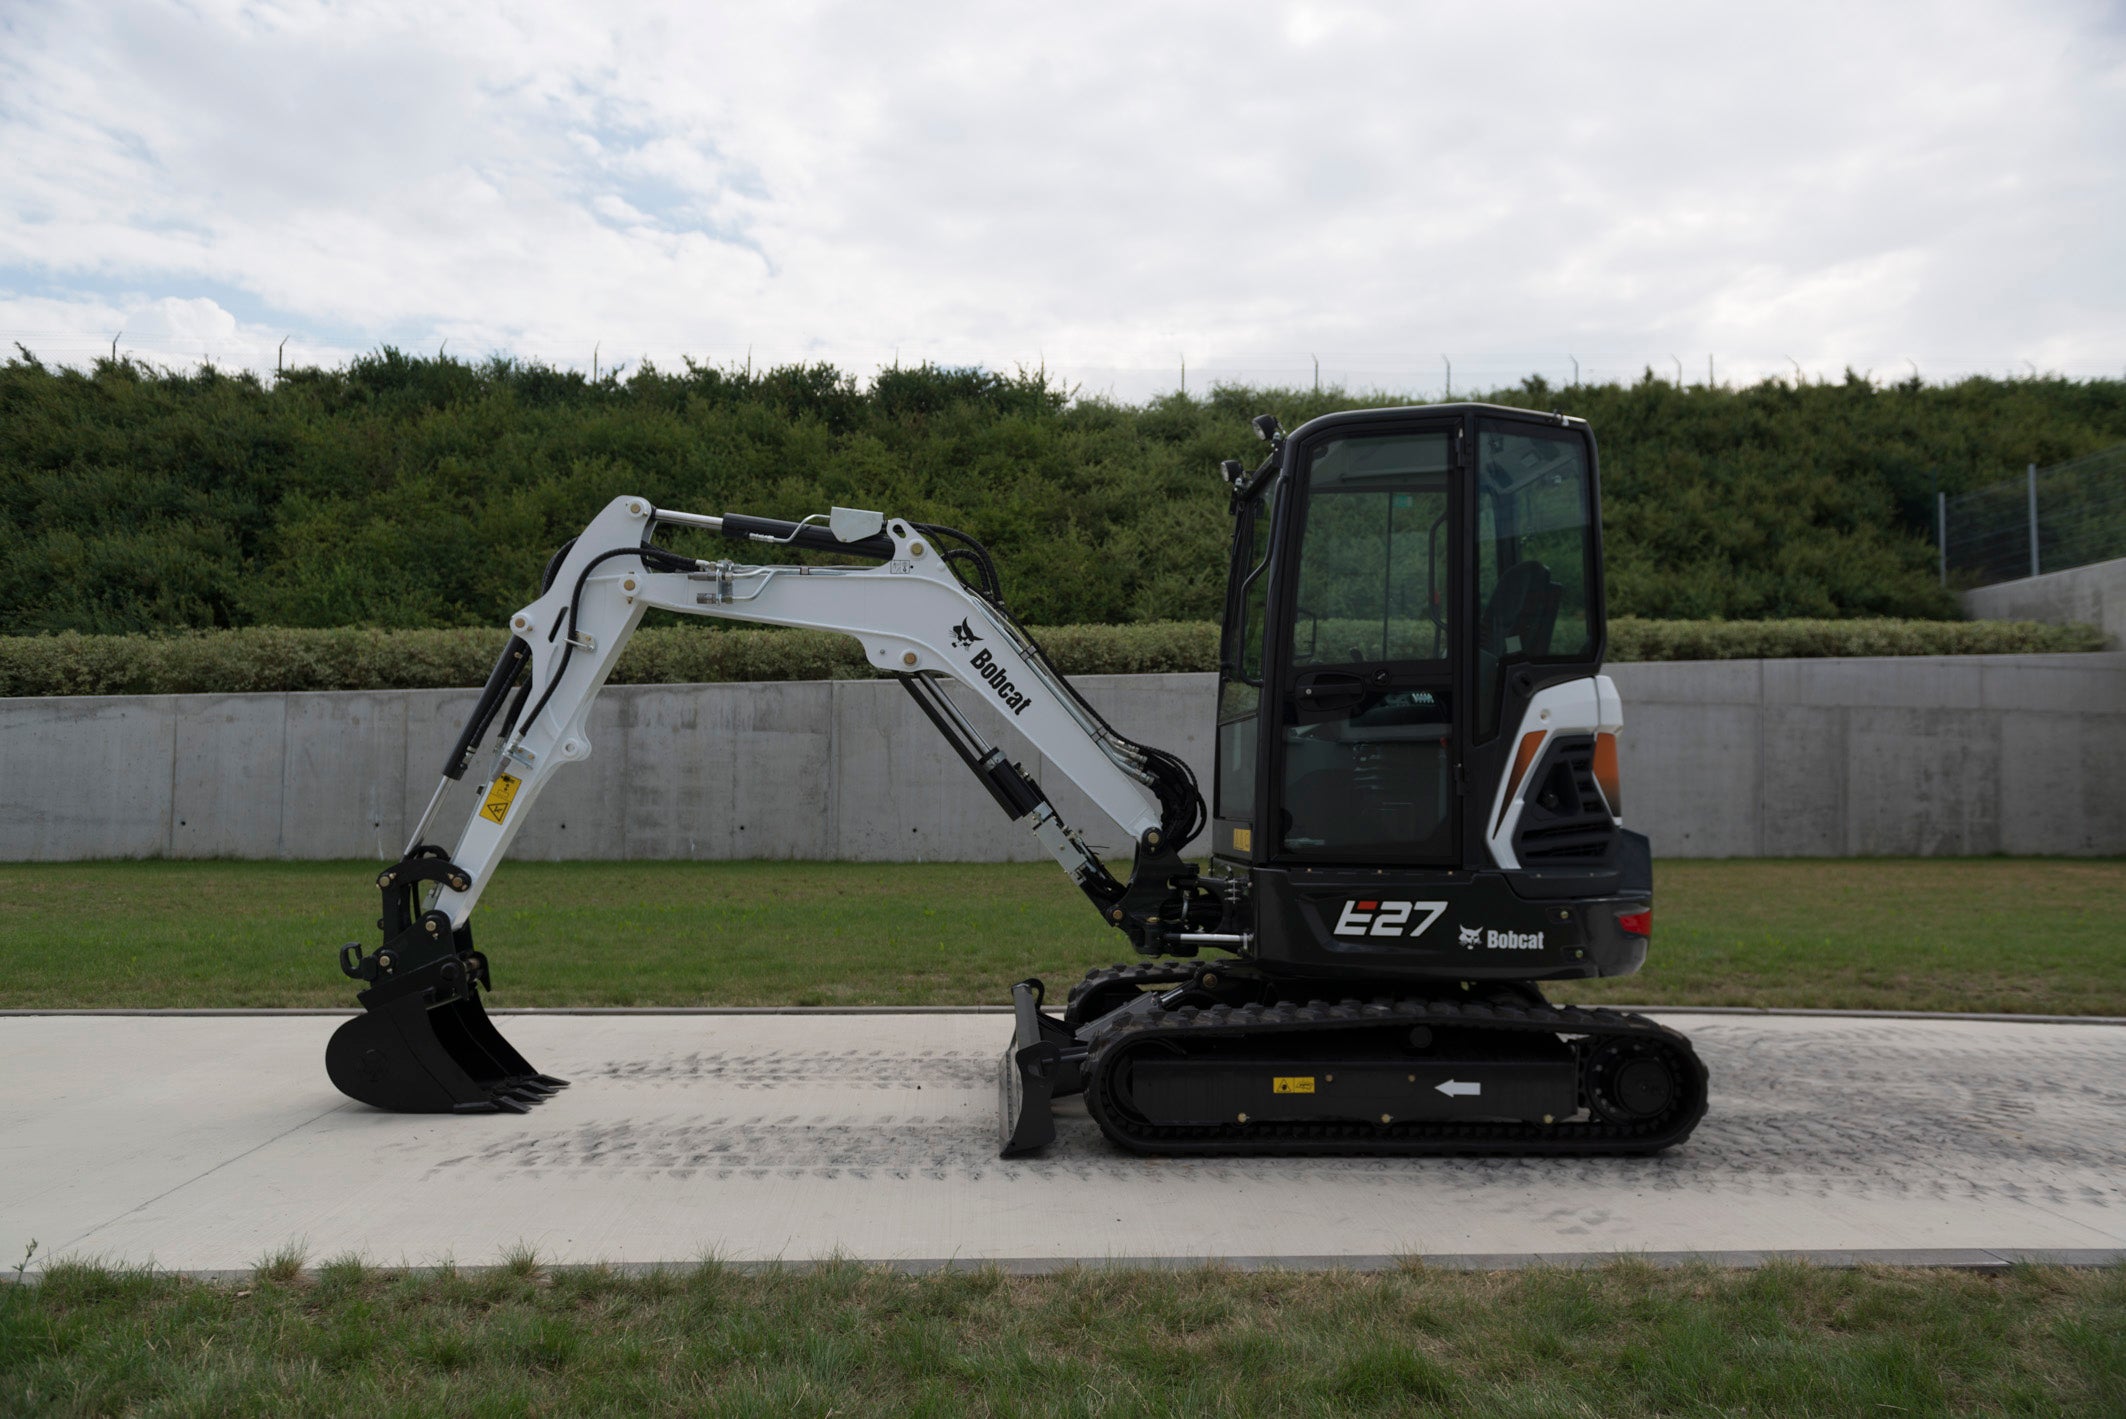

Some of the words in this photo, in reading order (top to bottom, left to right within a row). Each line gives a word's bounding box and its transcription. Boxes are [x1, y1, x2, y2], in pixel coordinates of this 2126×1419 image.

[970, 648, 1032, 716] Bobcat
[1333, 900, 1449, 937] E27
[1487, 930, 1545, 949] Bobcat
